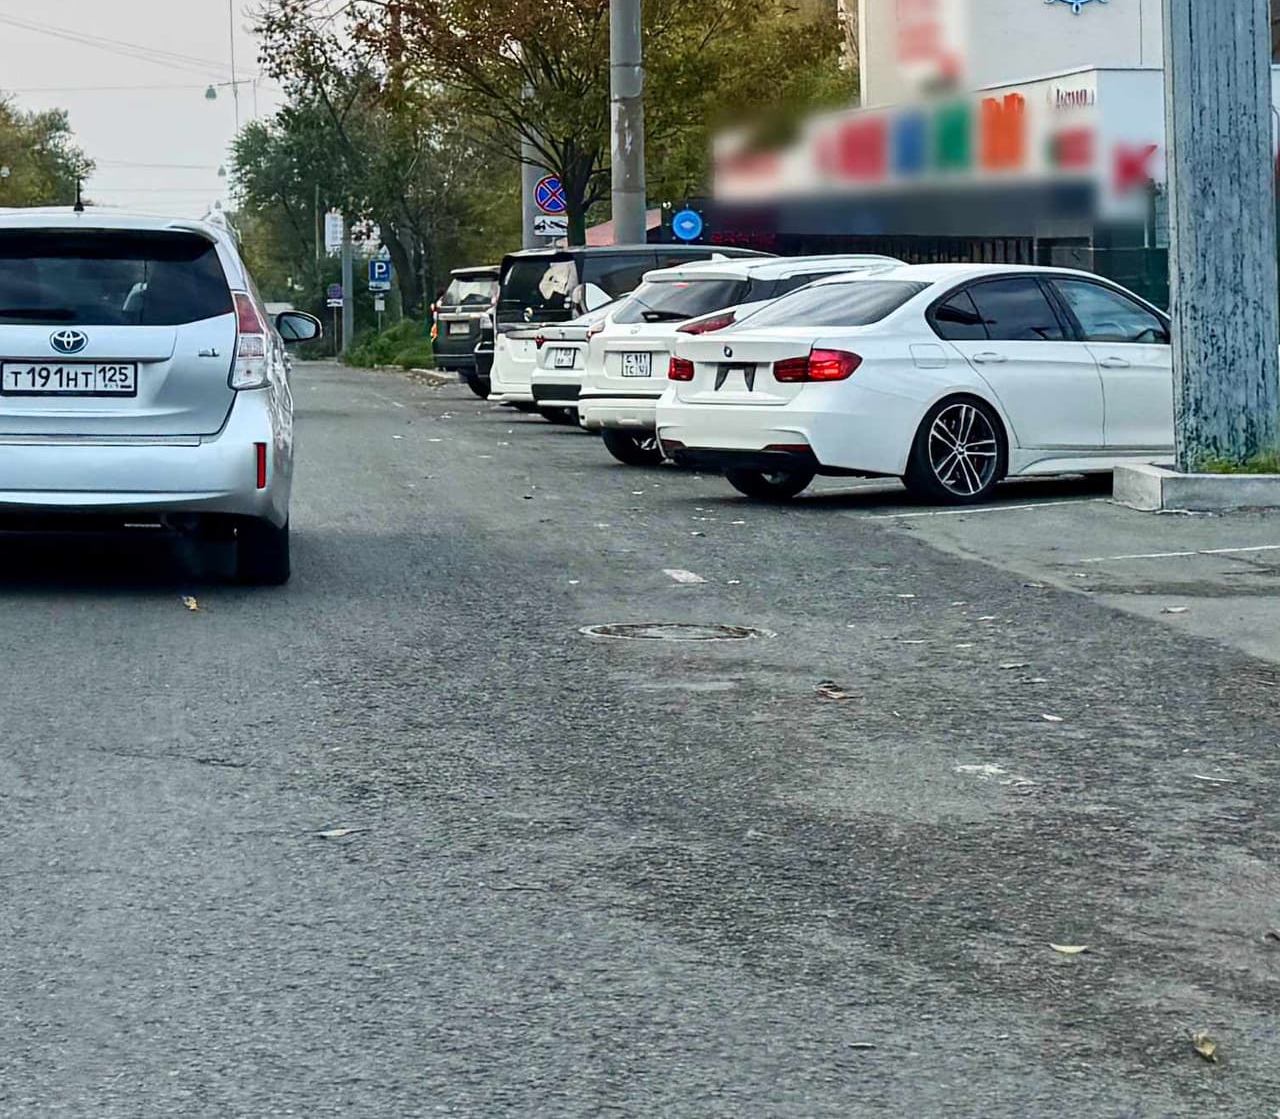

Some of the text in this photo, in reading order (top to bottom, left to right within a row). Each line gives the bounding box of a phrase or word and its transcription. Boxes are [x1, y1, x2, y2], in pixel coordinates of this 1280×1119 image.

[375, 262, 387, 279] P
[10, 366, 129, 388] Т191НТ 125
